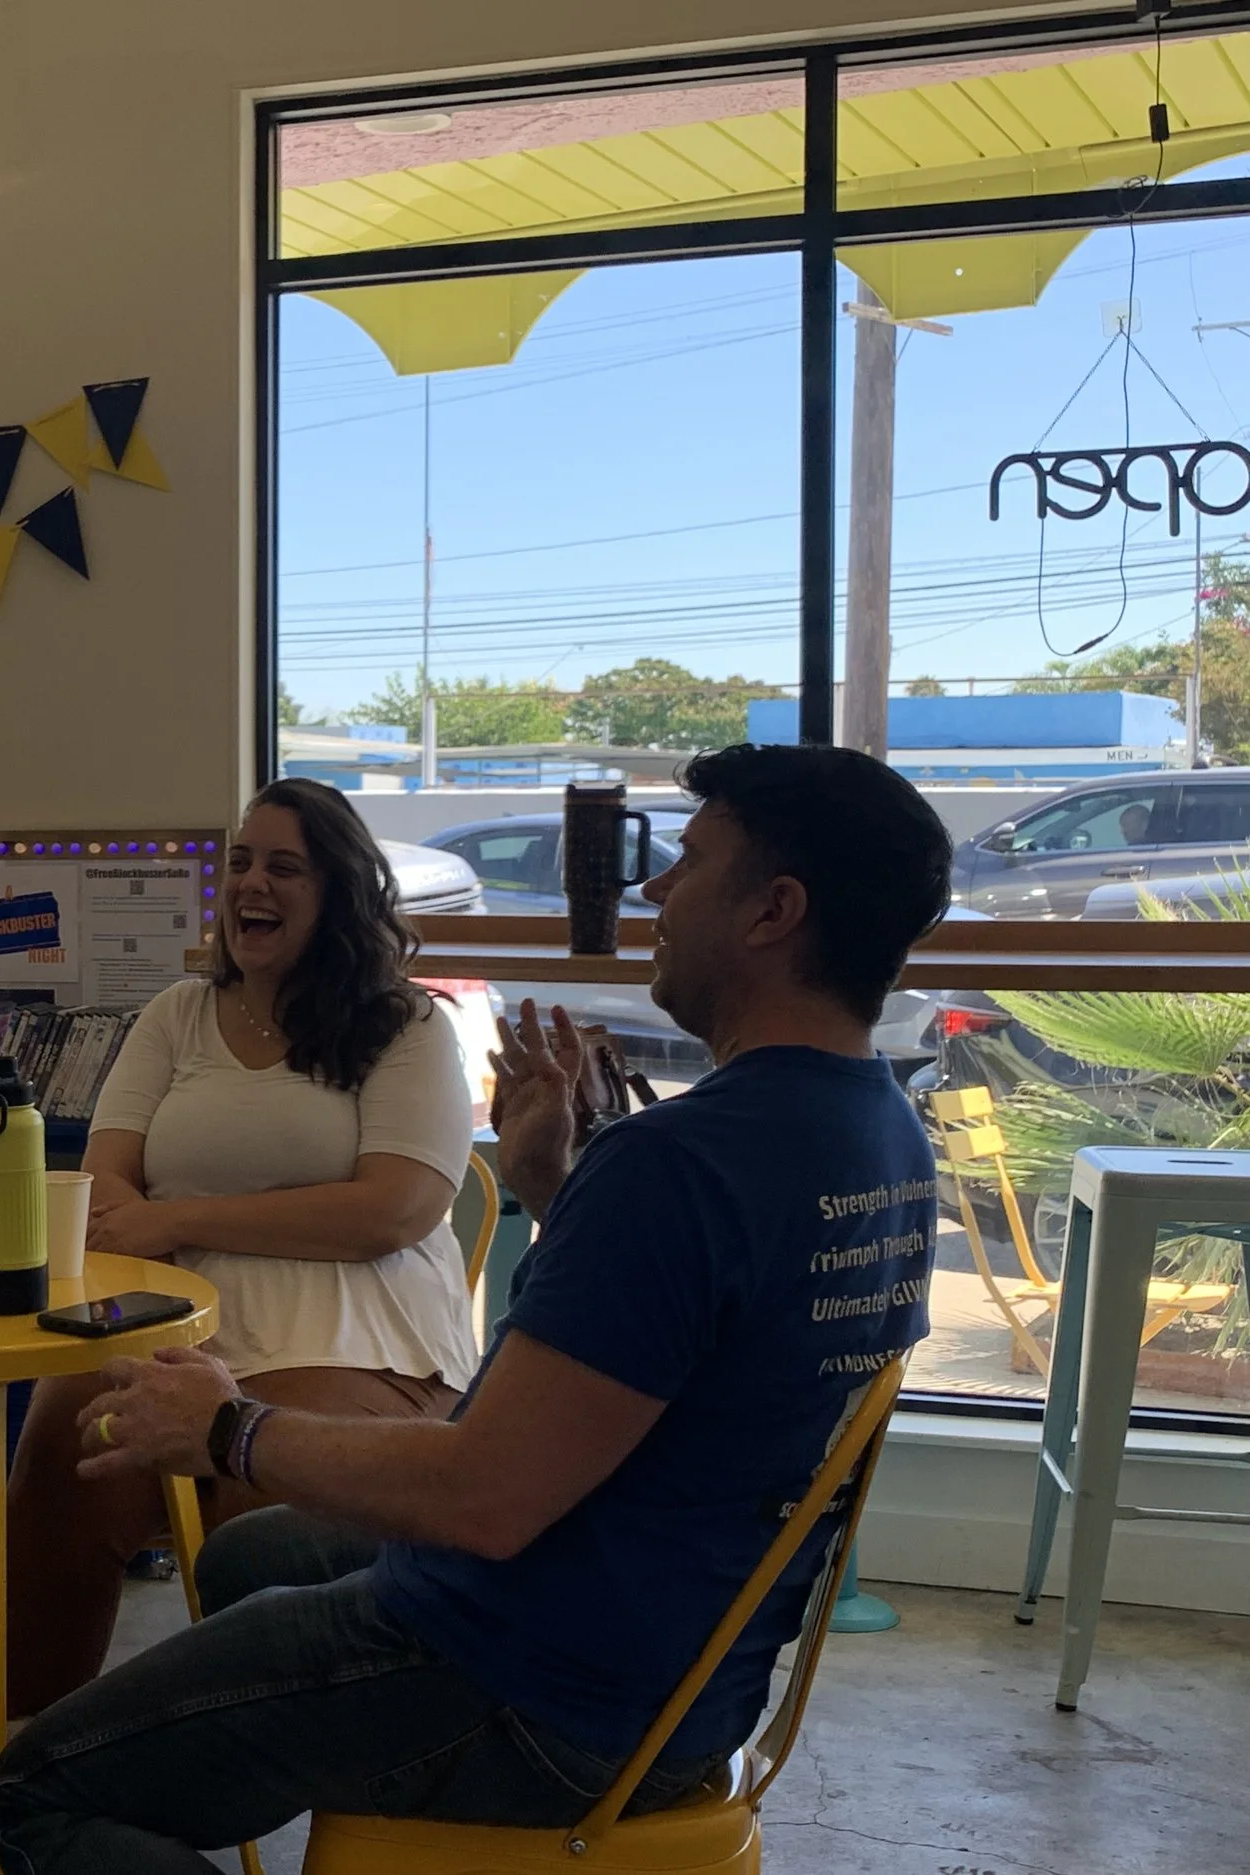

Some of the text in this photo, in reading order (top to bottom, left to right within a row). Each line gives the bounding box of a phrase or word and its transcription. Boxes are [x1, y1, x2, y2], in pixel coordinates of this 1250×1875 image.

[1106, 750, 1133, 761] MEN
[5, 884, 14, 900] A
[28, 948, 67, 964] NIGHT
[818, 1183, 889, 1220] Strength
[900, 1178, 937, 1203] Vulner
[810, 1238, 880, 1274] Triumph
